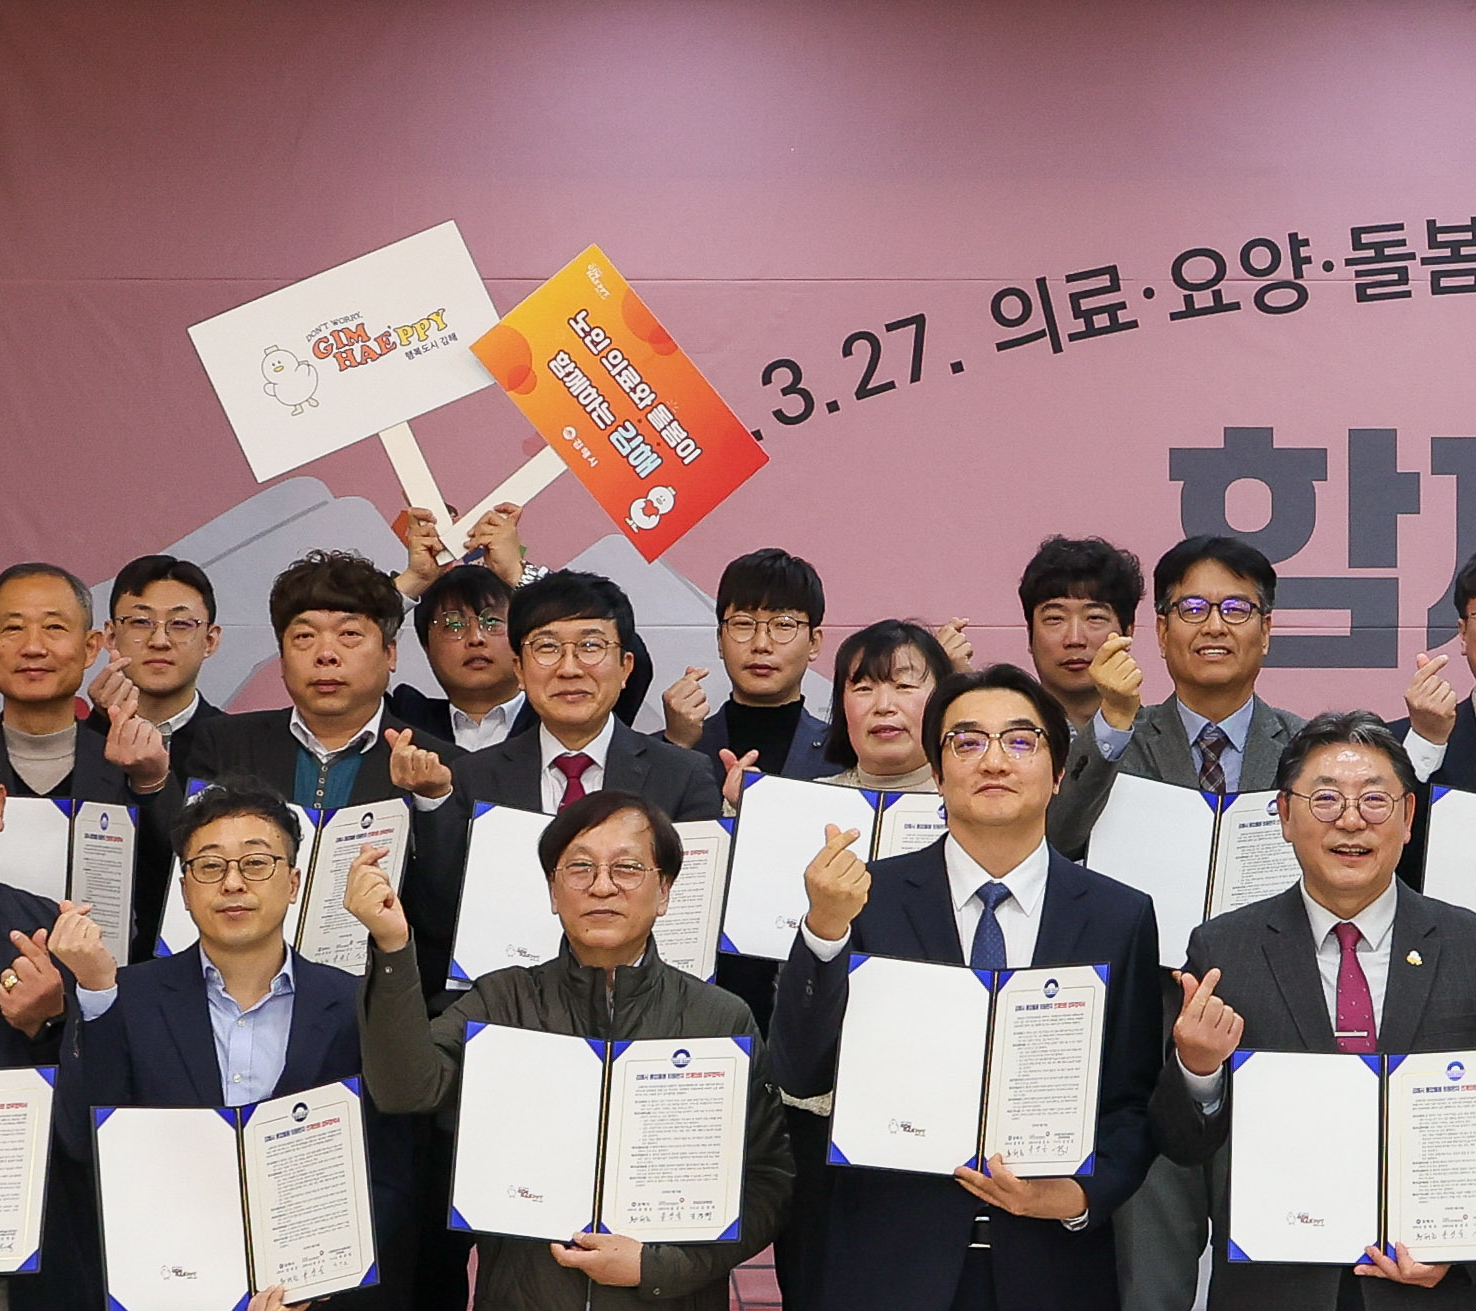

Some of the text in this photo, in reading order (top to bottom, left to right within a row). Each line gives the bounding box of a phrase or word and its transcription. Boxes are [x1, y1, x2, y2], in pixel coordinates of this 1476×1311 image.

[312, 322, 371, 359] GIM
[405, 332, 458, 360] 행복도시 김해
[567, 309, 703, 467] 노인 의료와 돌봄이
[547, 350, 663, 480] 함께하는 김해
[570, 437, 599, 469] 김해시
